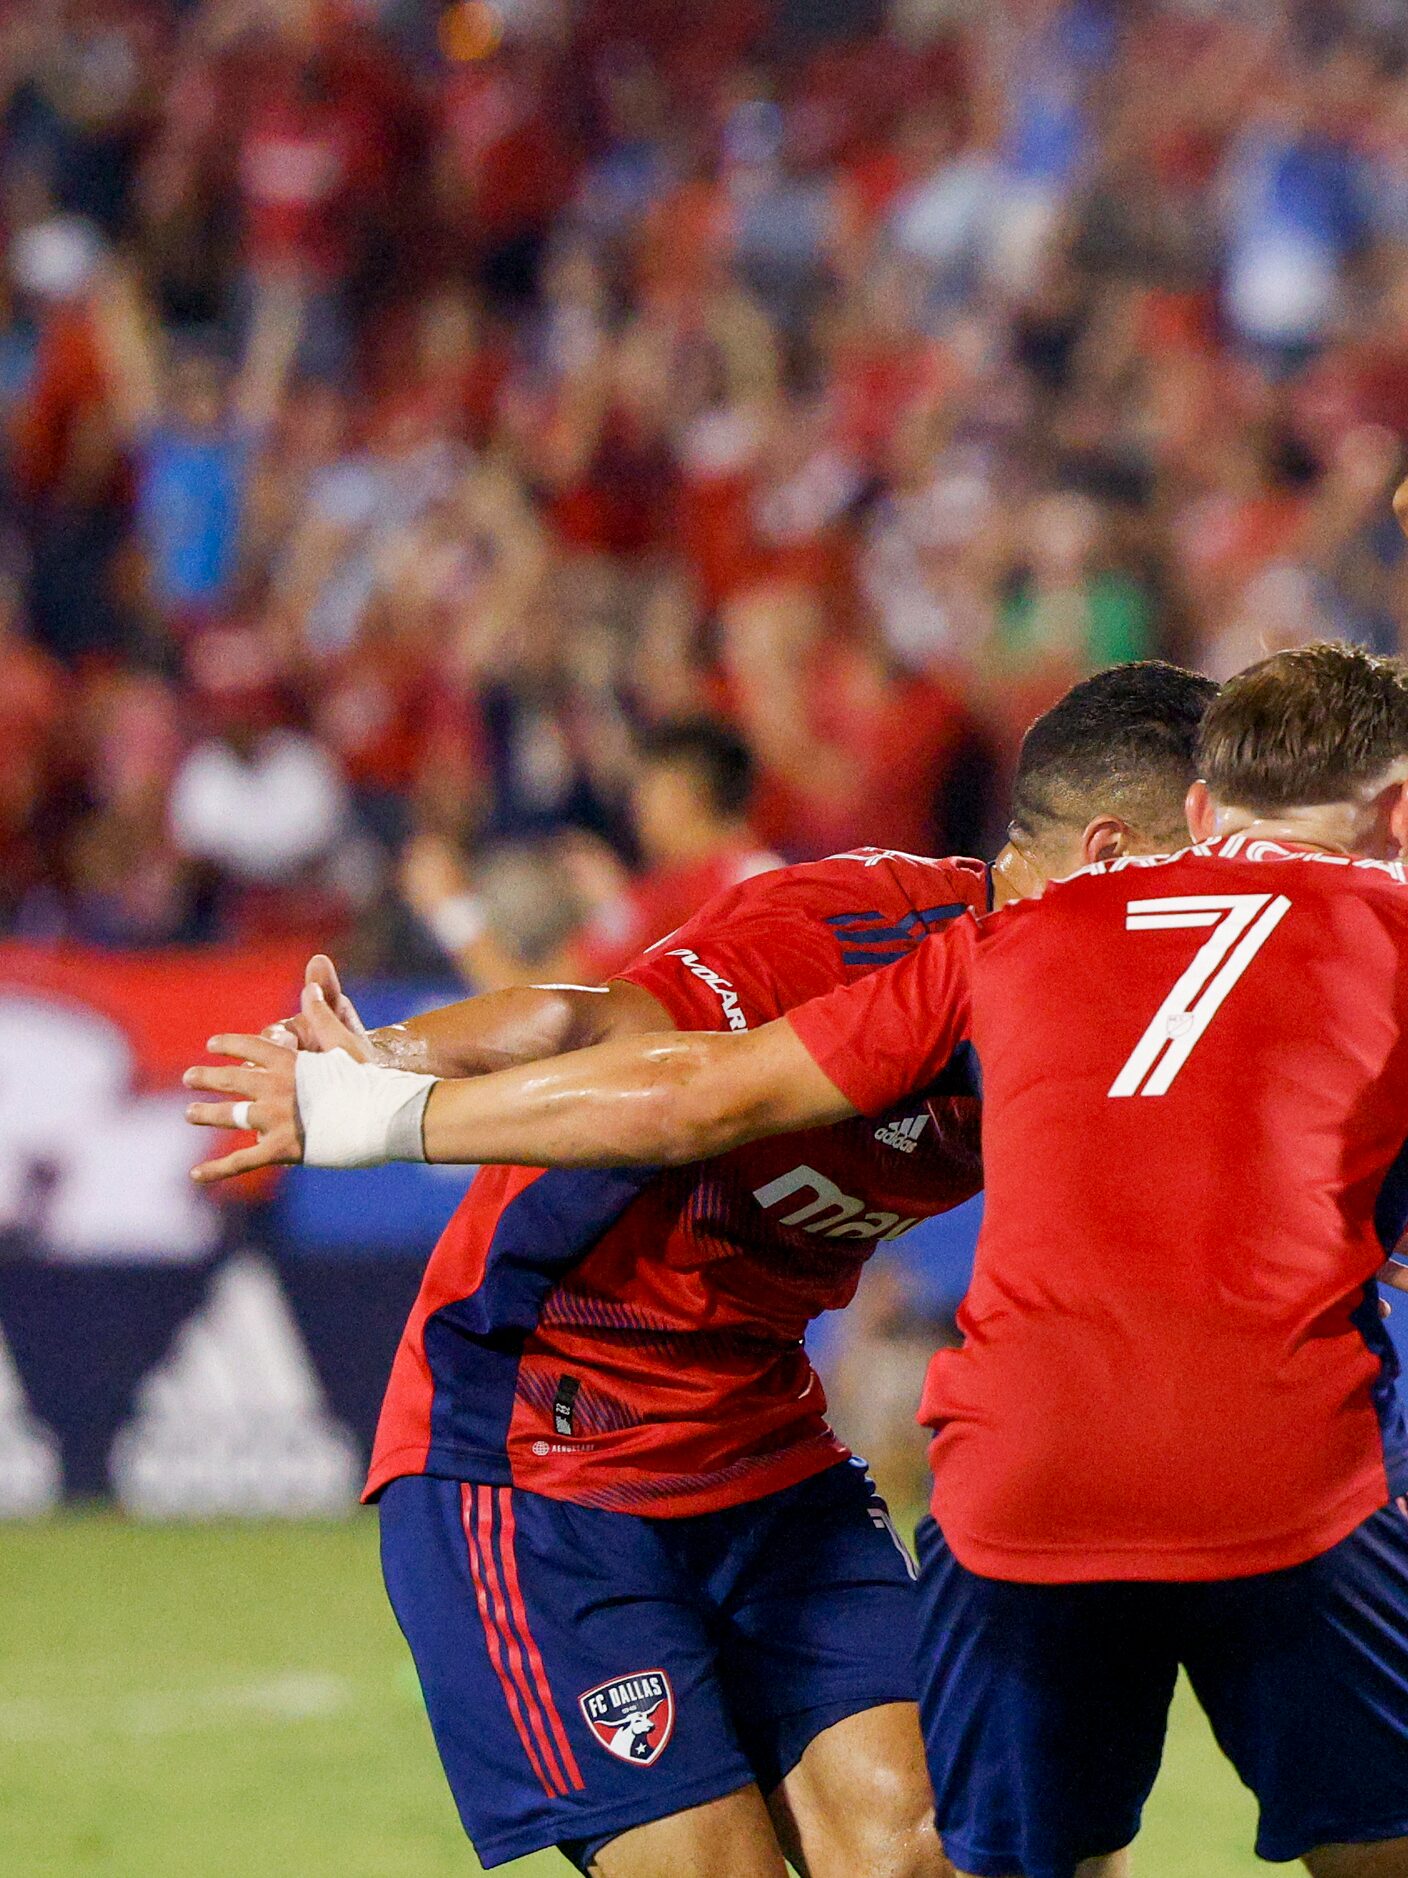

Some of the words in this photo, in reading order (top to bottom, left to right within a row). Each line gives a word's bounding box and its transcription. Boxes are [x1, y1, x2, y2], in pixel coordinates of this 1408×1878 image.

[1107, 893, 1293, 1098] 7
[588, 1694, 608, 1718] FC
[608, 1677, 663, 1708] DALLAS
